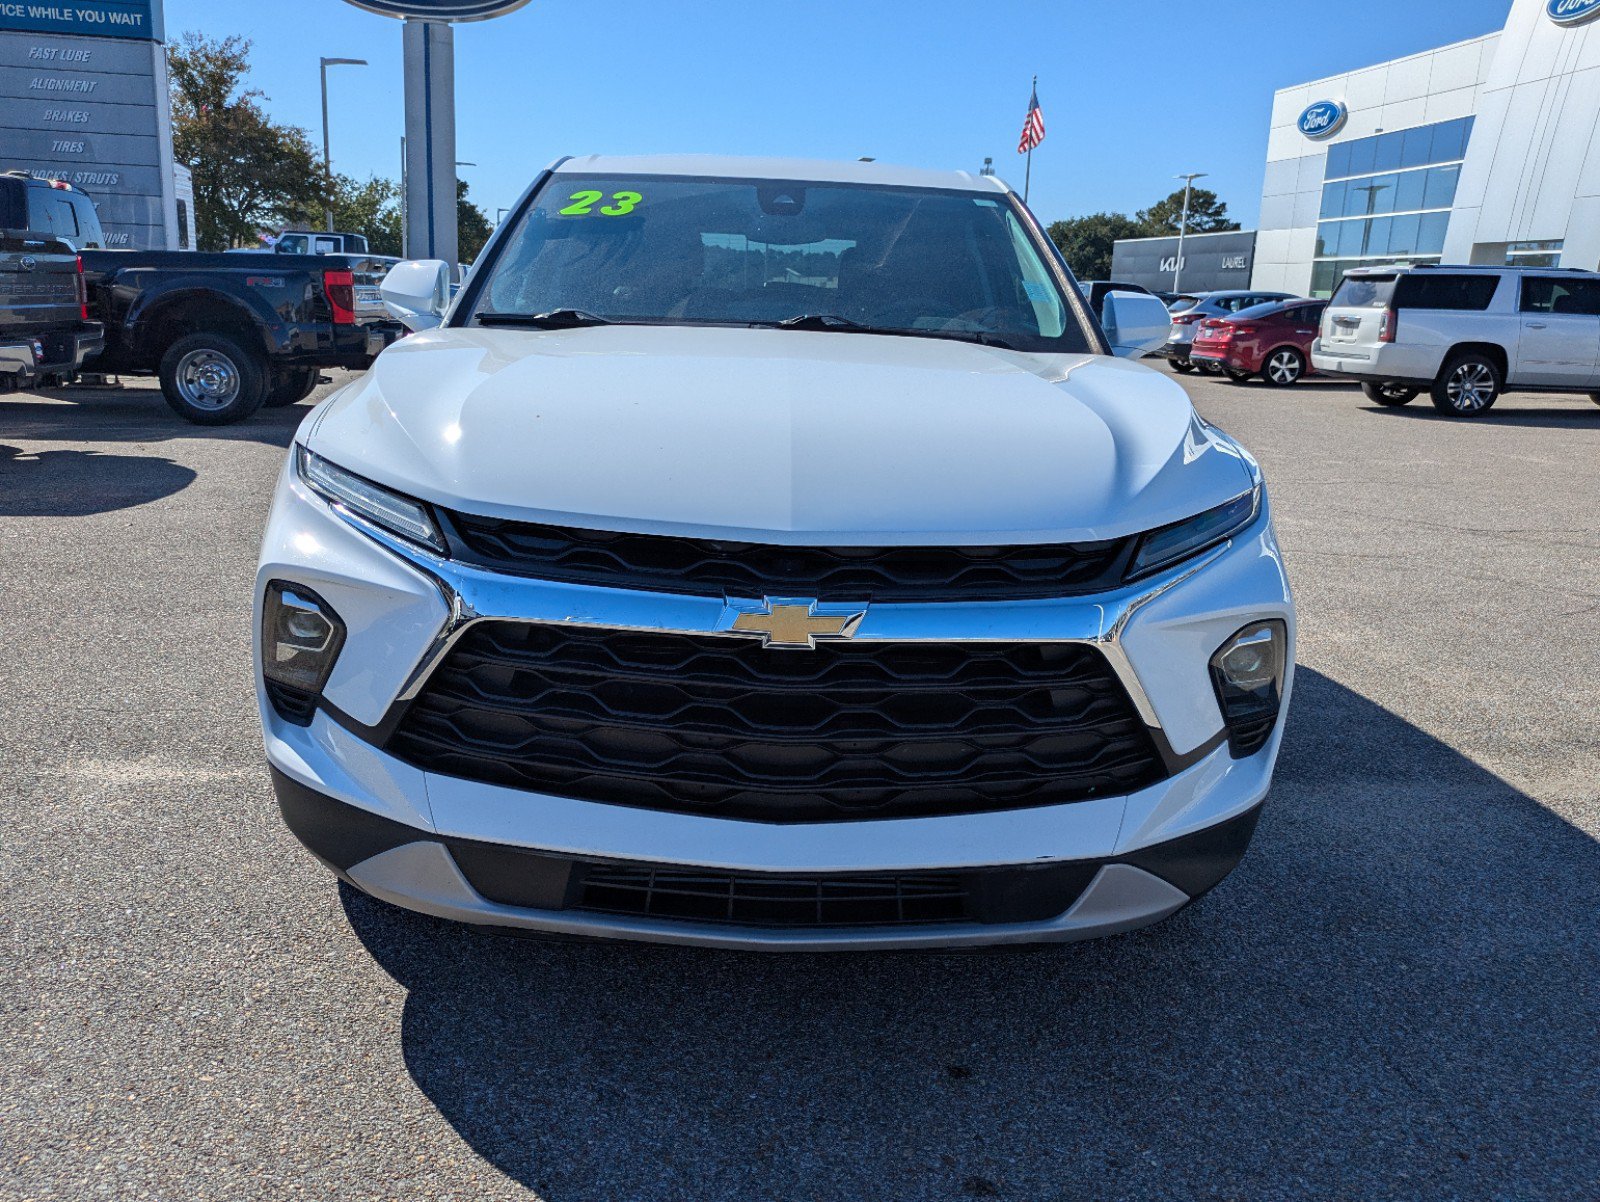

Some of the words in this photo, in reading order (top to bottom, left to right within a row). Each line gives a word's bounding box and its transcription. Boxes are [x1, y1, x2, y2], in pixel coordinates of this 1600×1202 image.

[0, 4, 25, 17] ICE
[28, 6, 73, 21] WHILE
[76, 10, 105, 23] YOU
[108, 12, 142, 25] WAIT
[29, 47, 59, 61] FAST
[60, 49, 92, 63] LUBE
[30, 77, 98, 93] ALIGNMENT
[44, 109, 90, 123] BRAKES
[1303, 107, 1331, 130] Ford
[52, 140, 84, 153] TIRES
[75, 171, 119, 185] STRUTS
[1221, 256, 1247, 269] LAUREL
